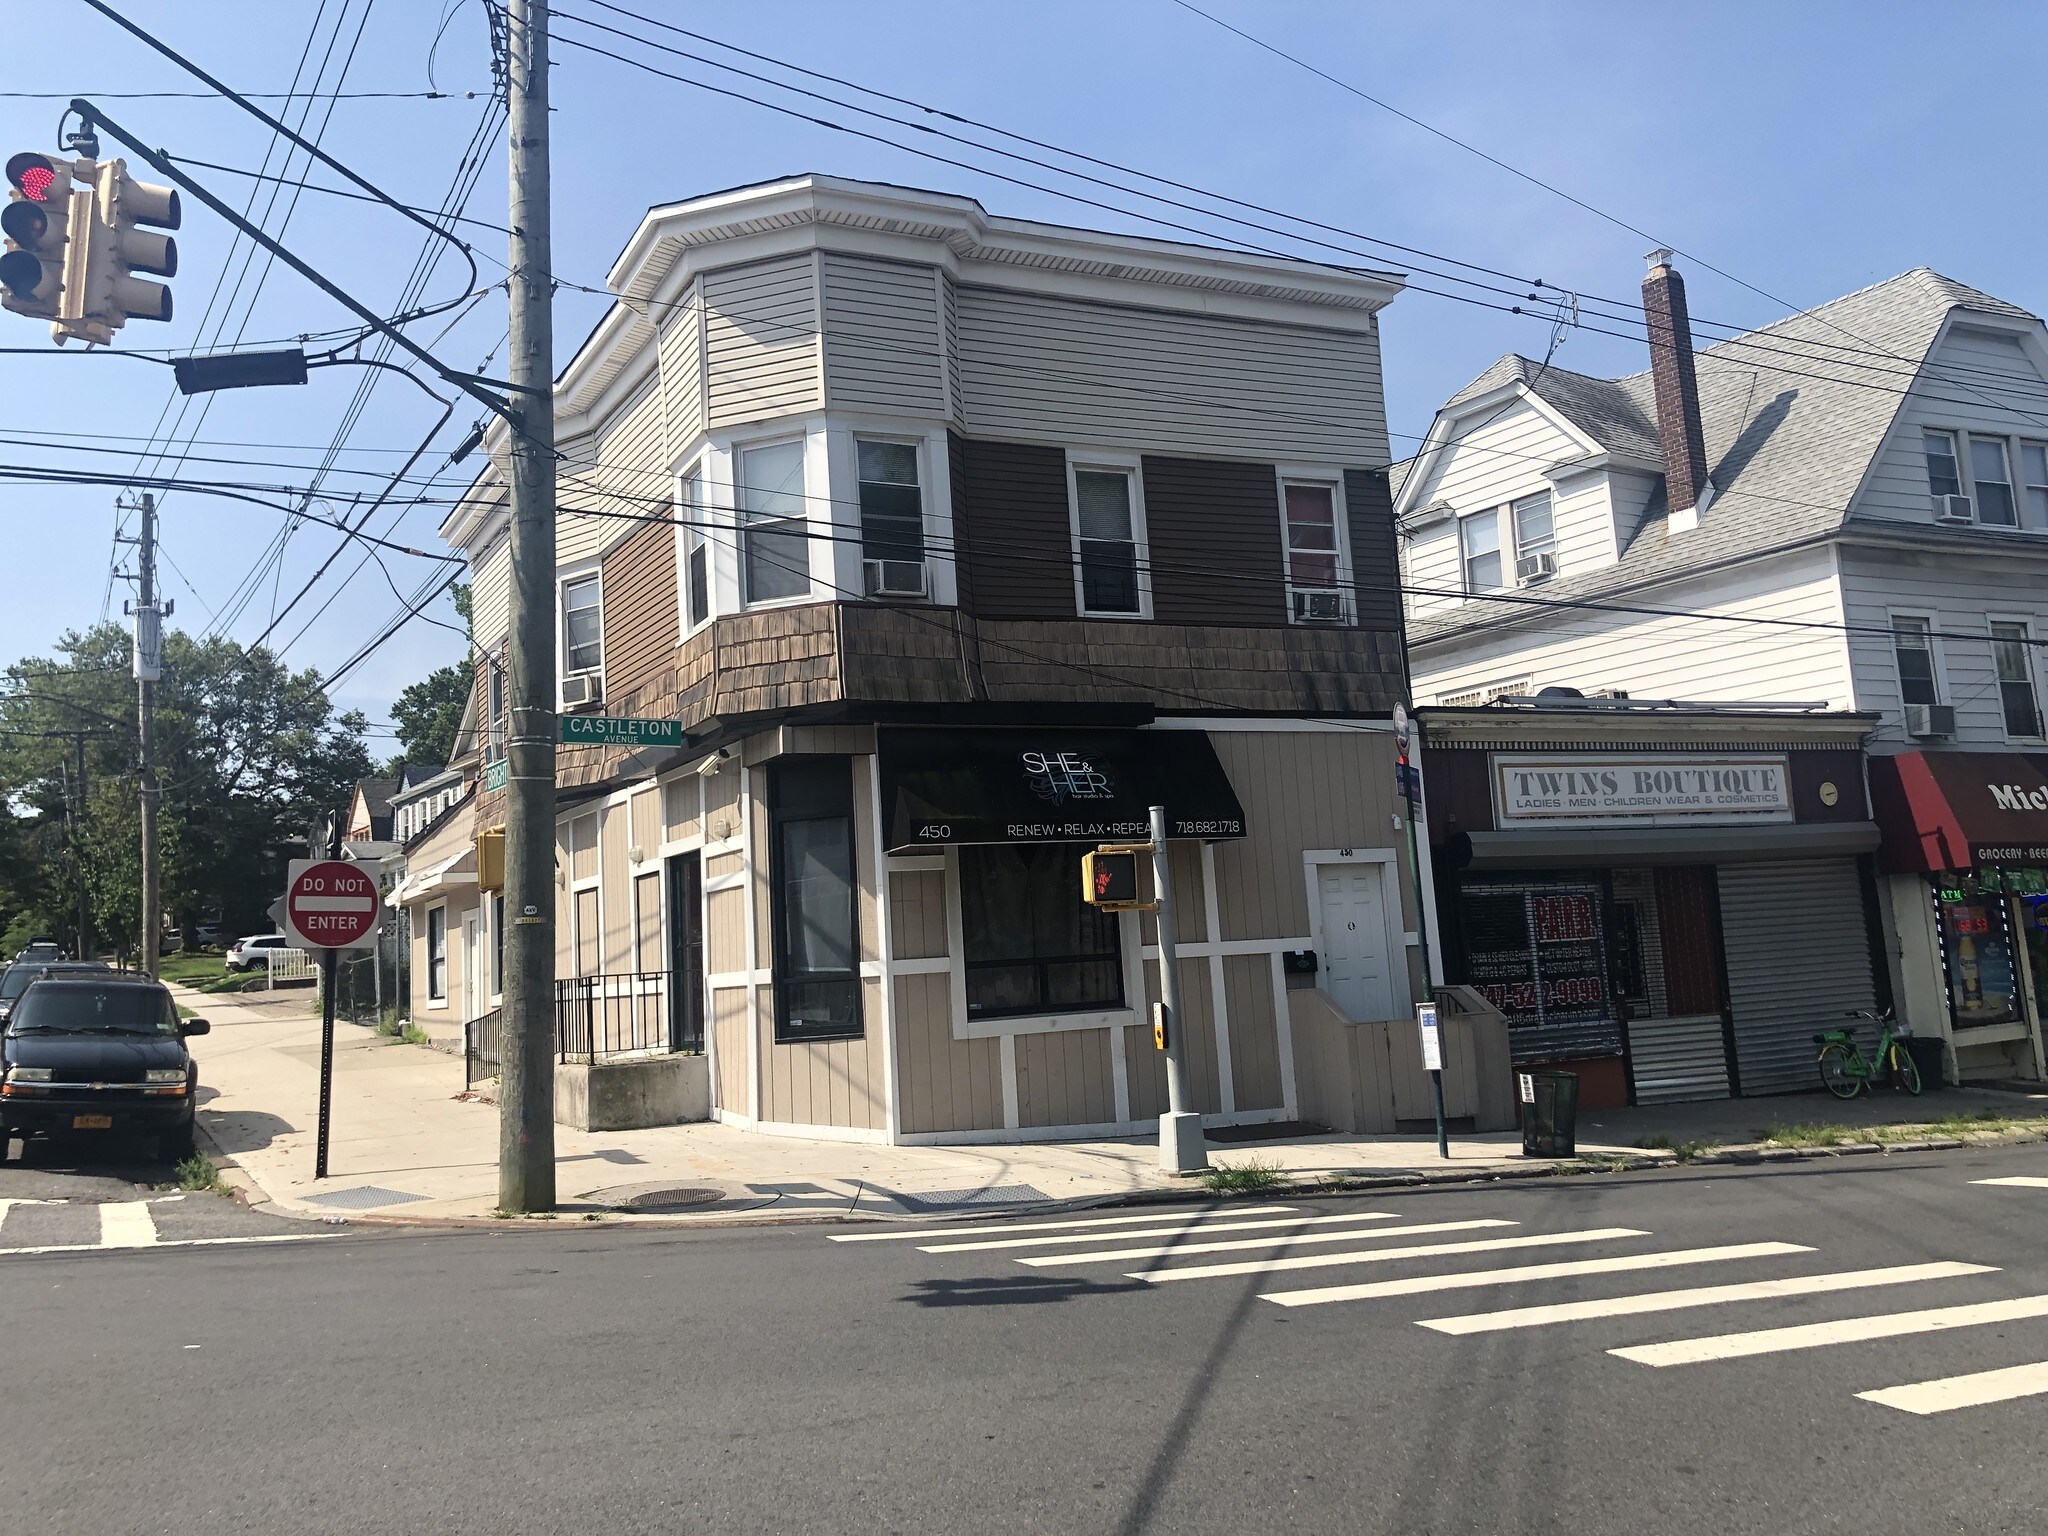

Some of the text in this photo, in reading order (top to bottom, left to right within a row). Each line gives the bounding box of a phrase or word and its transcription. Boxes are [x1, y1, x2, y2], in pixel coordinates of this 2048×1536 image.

[570, 719, 672, 736] CASTLETON
[603, 735, 639, 743] AVENUE
[1022, 752, 1094, 773] SHE &
[488, 762, 508, 789] BRIGHT
[1514, 769, 1777, 796] TWINS BOUTIQUE
[1048, 773, 1111, 793] HER
[1516, 794, 1779, 808] LADIES MEN CHILDREN WEAR & COSMETICS
[918, 821, 1240, 838] 450 RENEW RELAX REPEA 718.682.1718
[1340, 849, 1353, 857] 450
[1978, 848, 2022, 860] GROCERY
[303, 878, 365, 892] DO NOT
[1940, 890, 1962, 899] ATM
[308, 916, 358, 930] ENTER
